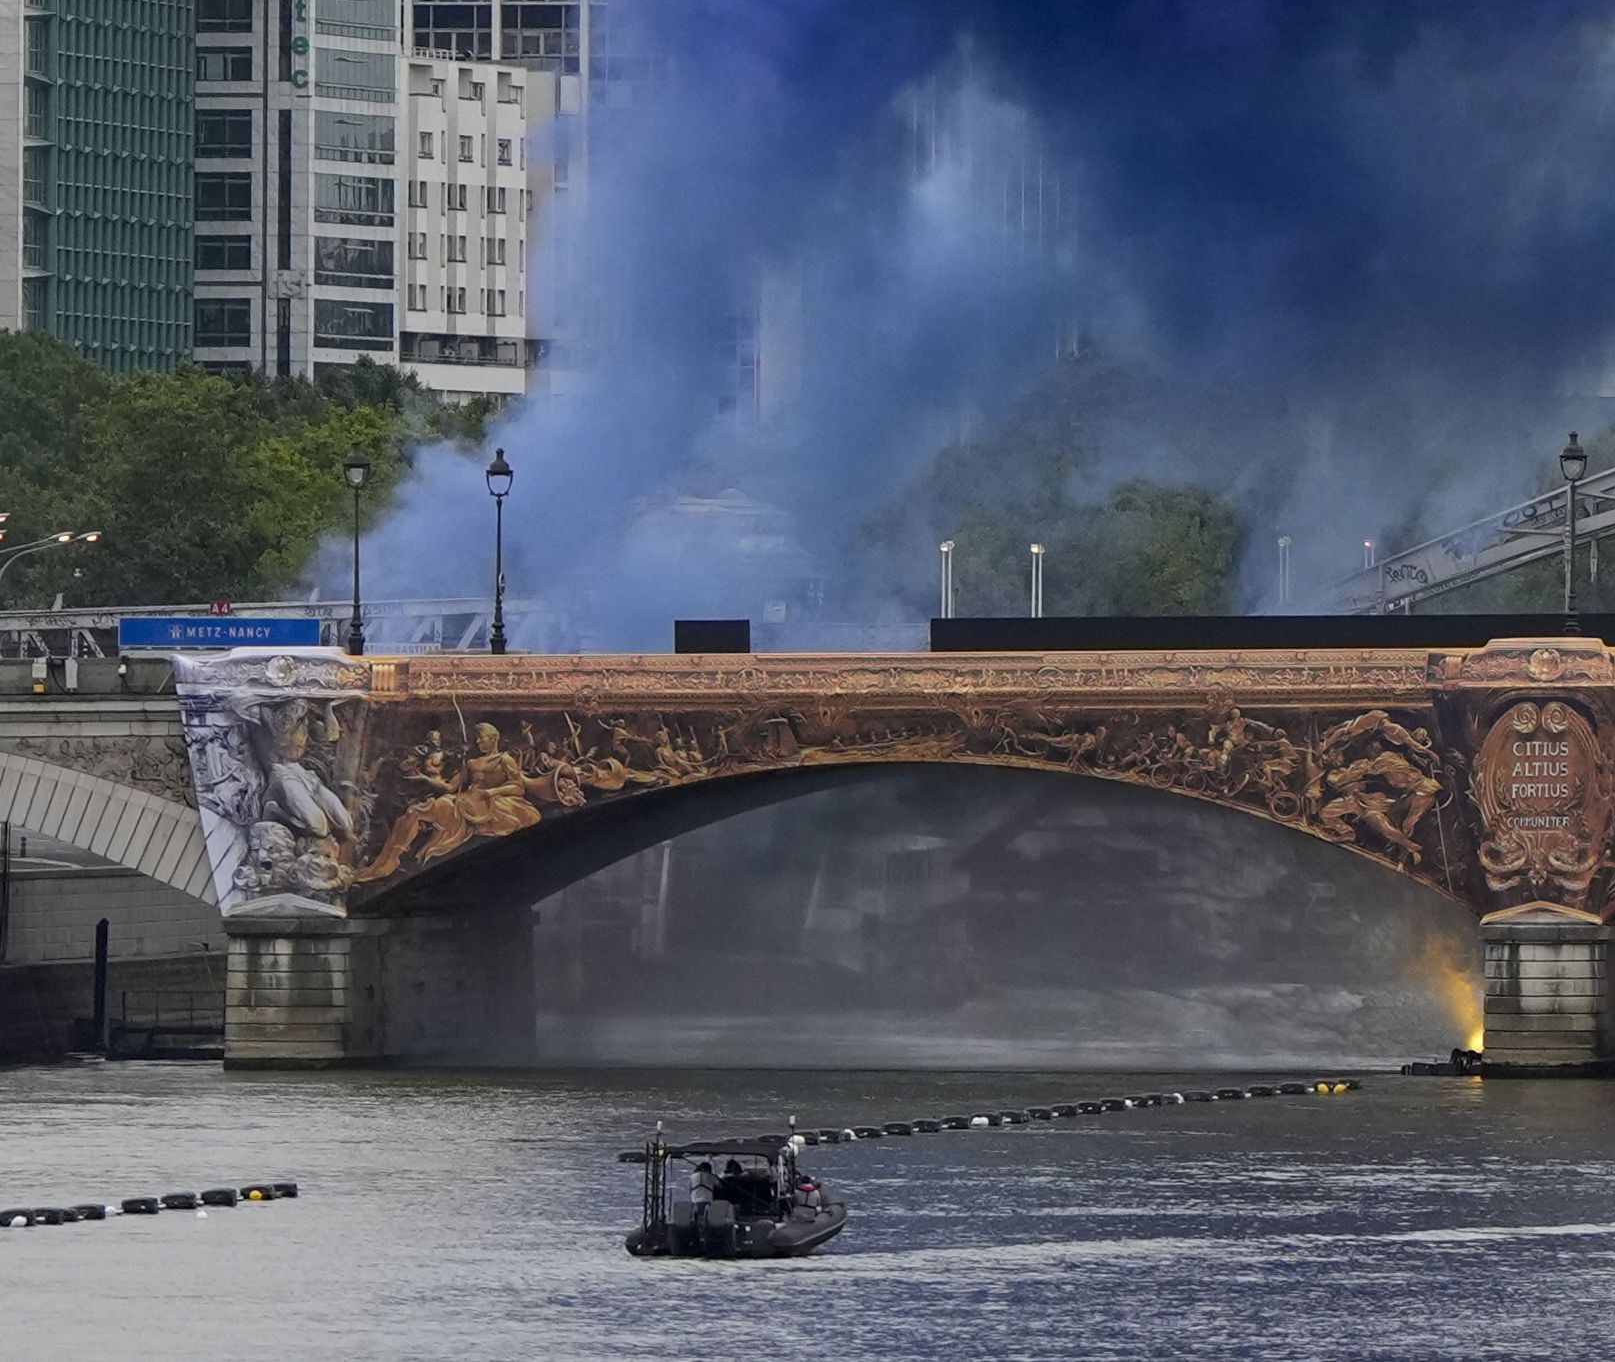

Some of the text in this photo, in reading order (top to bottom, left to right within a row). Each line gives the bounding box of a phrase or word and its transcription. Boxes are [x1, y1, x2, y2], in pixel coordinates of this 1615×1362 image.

[211, 603, 228, 614] A4
[186, 626, 271, 638] METZ-NANCY
[1512, 741, 1569, 757] CITIUS
[1511, 761, 1569, 777] ALTIUS
[1511, 783, 1569, 799] FORTIUS
[1506, 816, 1570, 828] COMMUNITER
